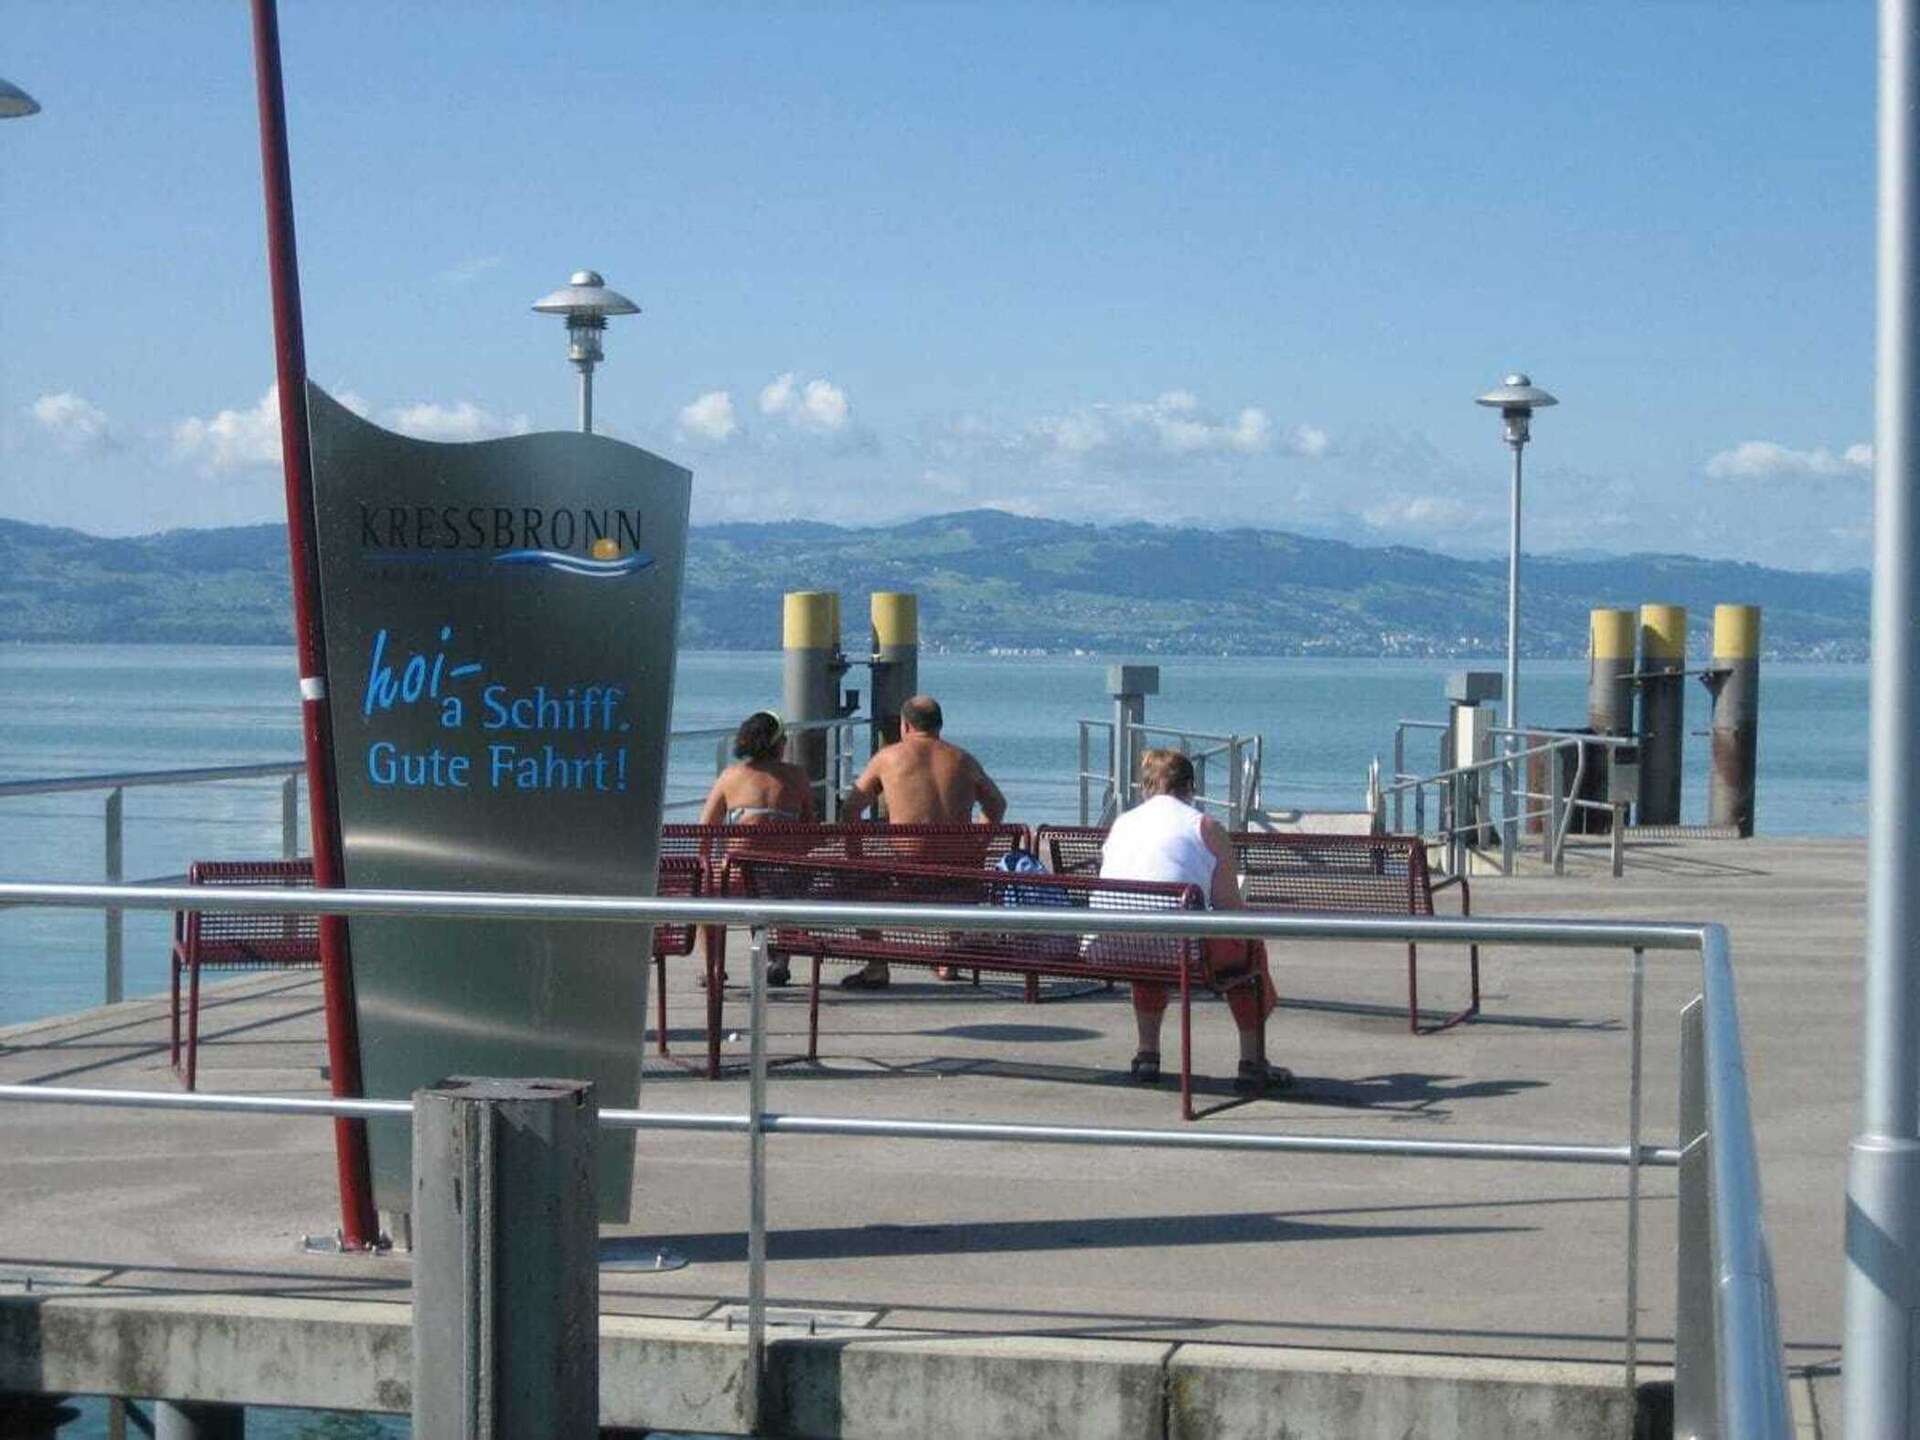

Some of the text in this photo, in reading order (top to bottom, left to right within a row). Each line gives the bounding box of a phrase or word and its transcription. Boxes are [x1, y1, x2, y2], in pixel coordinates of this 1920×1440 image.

[360, 506, 643, 551] KRESSBRONN
[441, 695, 463, 729] a
[482, 684, 631, 731] Schiff.
[367, 741, 628, 791] Gute Fahrt!
